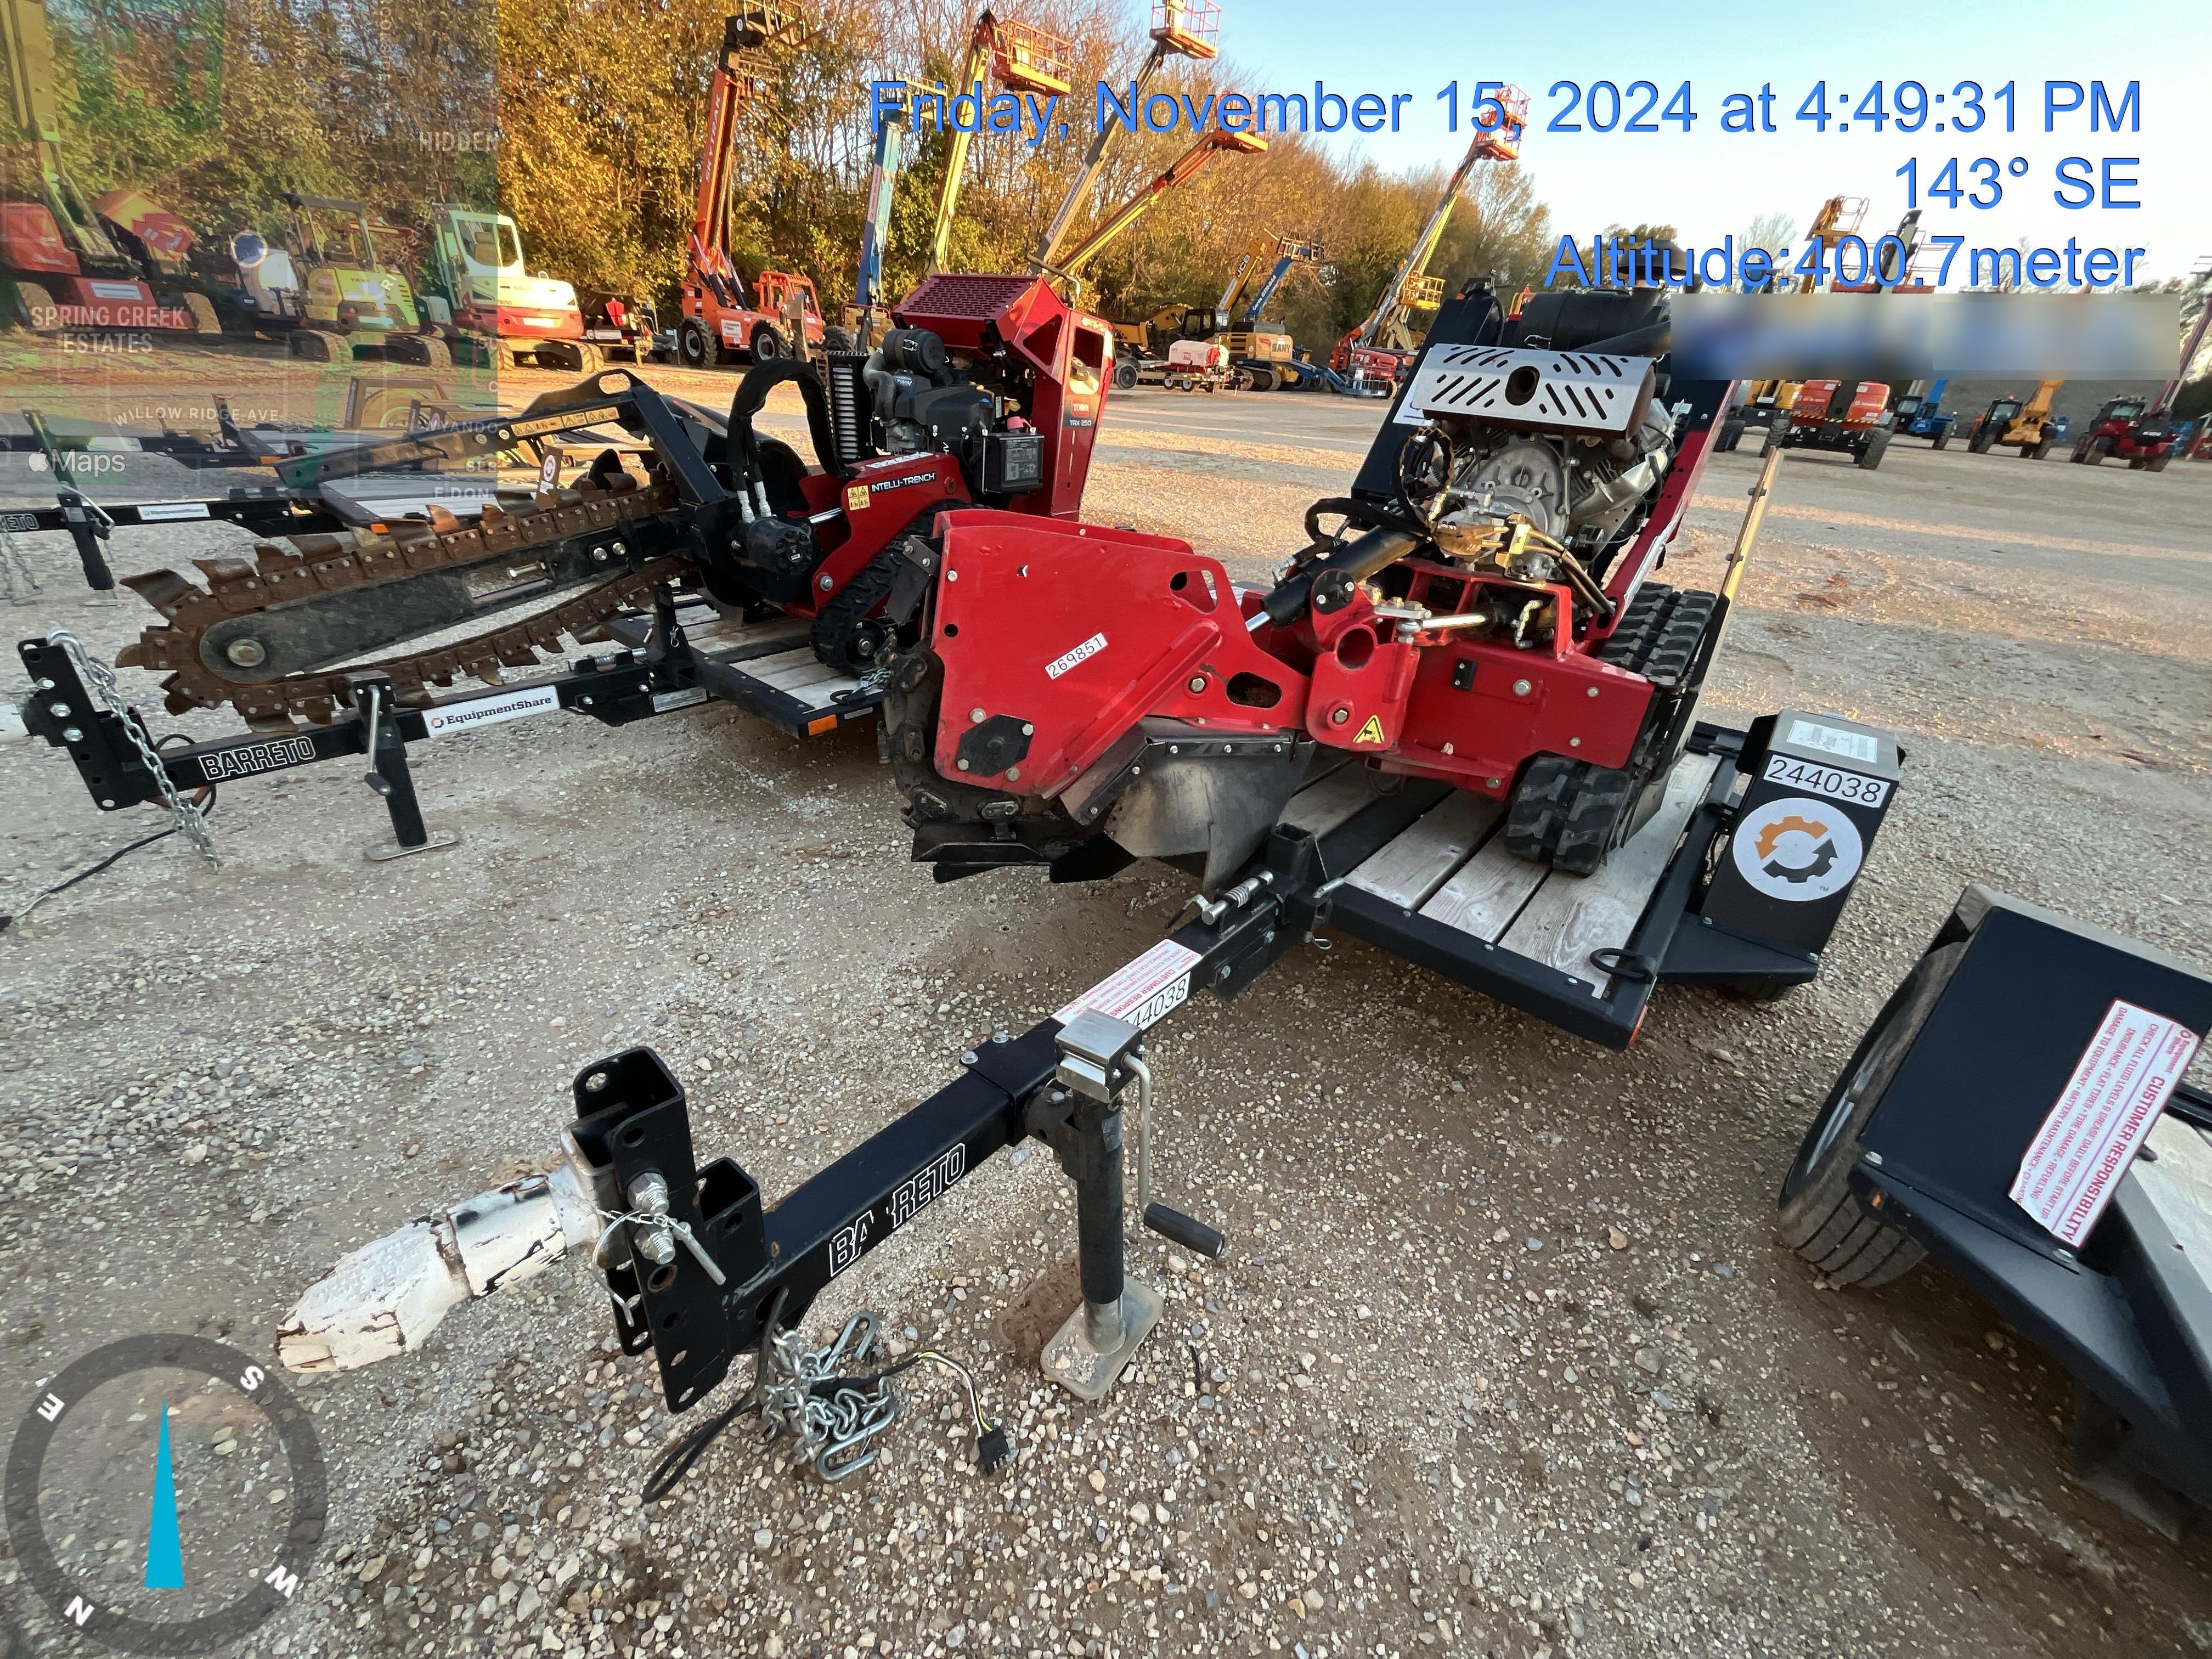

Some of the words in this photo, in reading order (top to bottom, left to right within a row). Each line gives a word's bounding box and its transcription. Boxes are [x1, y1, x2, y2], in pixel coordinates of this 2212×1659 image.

[1053, 170, 1086, 229] EquipmentShare
[1236, 253, 1251, 278] JCB
[1272, 343, 1290, 353] SANY
[871, 473, 935, 492] INTELLI-TRENCH
[1048, 637, 1102, 677] 269851
[445, 695, 552, 725] EquipmentShare
[198, 736, 317, 781] BARRETO
[1768, 759, 1881, 803] 244038
[1138, 969, 1176, 994] CUSTOMER
[1109, 992, 1143, 1017] RESPONS
[1126, 978, 1186, 1026] 44038
[2105, 1006, 2126, 1037] DAMAGE
[2139, 1022, 2159, 1047] CHECK
[2100, 1035, 2110, 1047] TO
[2108, 1027, 2135, 1068] INSURANCE
[2132, 1046, 2145, 1060] ALL
[2076, 1045, 2104, 1087] EQUIPMENT
[2096, 1070, 2110, 1088] FLAT
[2119, 1058, 2137, 1081] FLUID
[2057, 1088, 2079, 1121] BATTERY
[2084, 1086, 2100, 1110] TIRES
[2105, 1079, 2125, 1107] LEVELS
[2072, 1111, 2086, 1130] TIRE
[2118, 1074, 2165, 1142] CUSTOMER
[2086, 1110, 2107, 1139] GREASE
[2028, 1118, 2061, 1170] MAINTENANCE
[2055, 1128, 2076, 1159] DAMAGE
[2074, 1137, 2091, 1160] DAILY
[2030, 1160, 2056, 1201] REFUELING
[2058, 1158, 2079, 1187] BEFORE
[2046, 1184, 2063, 1208] START
[2061, 1138, 2126, 1242] RESPONSIBILITY
[829, 1142, 966, 1277] BARETO
[2039, 1205, 2050, 1220] UP
